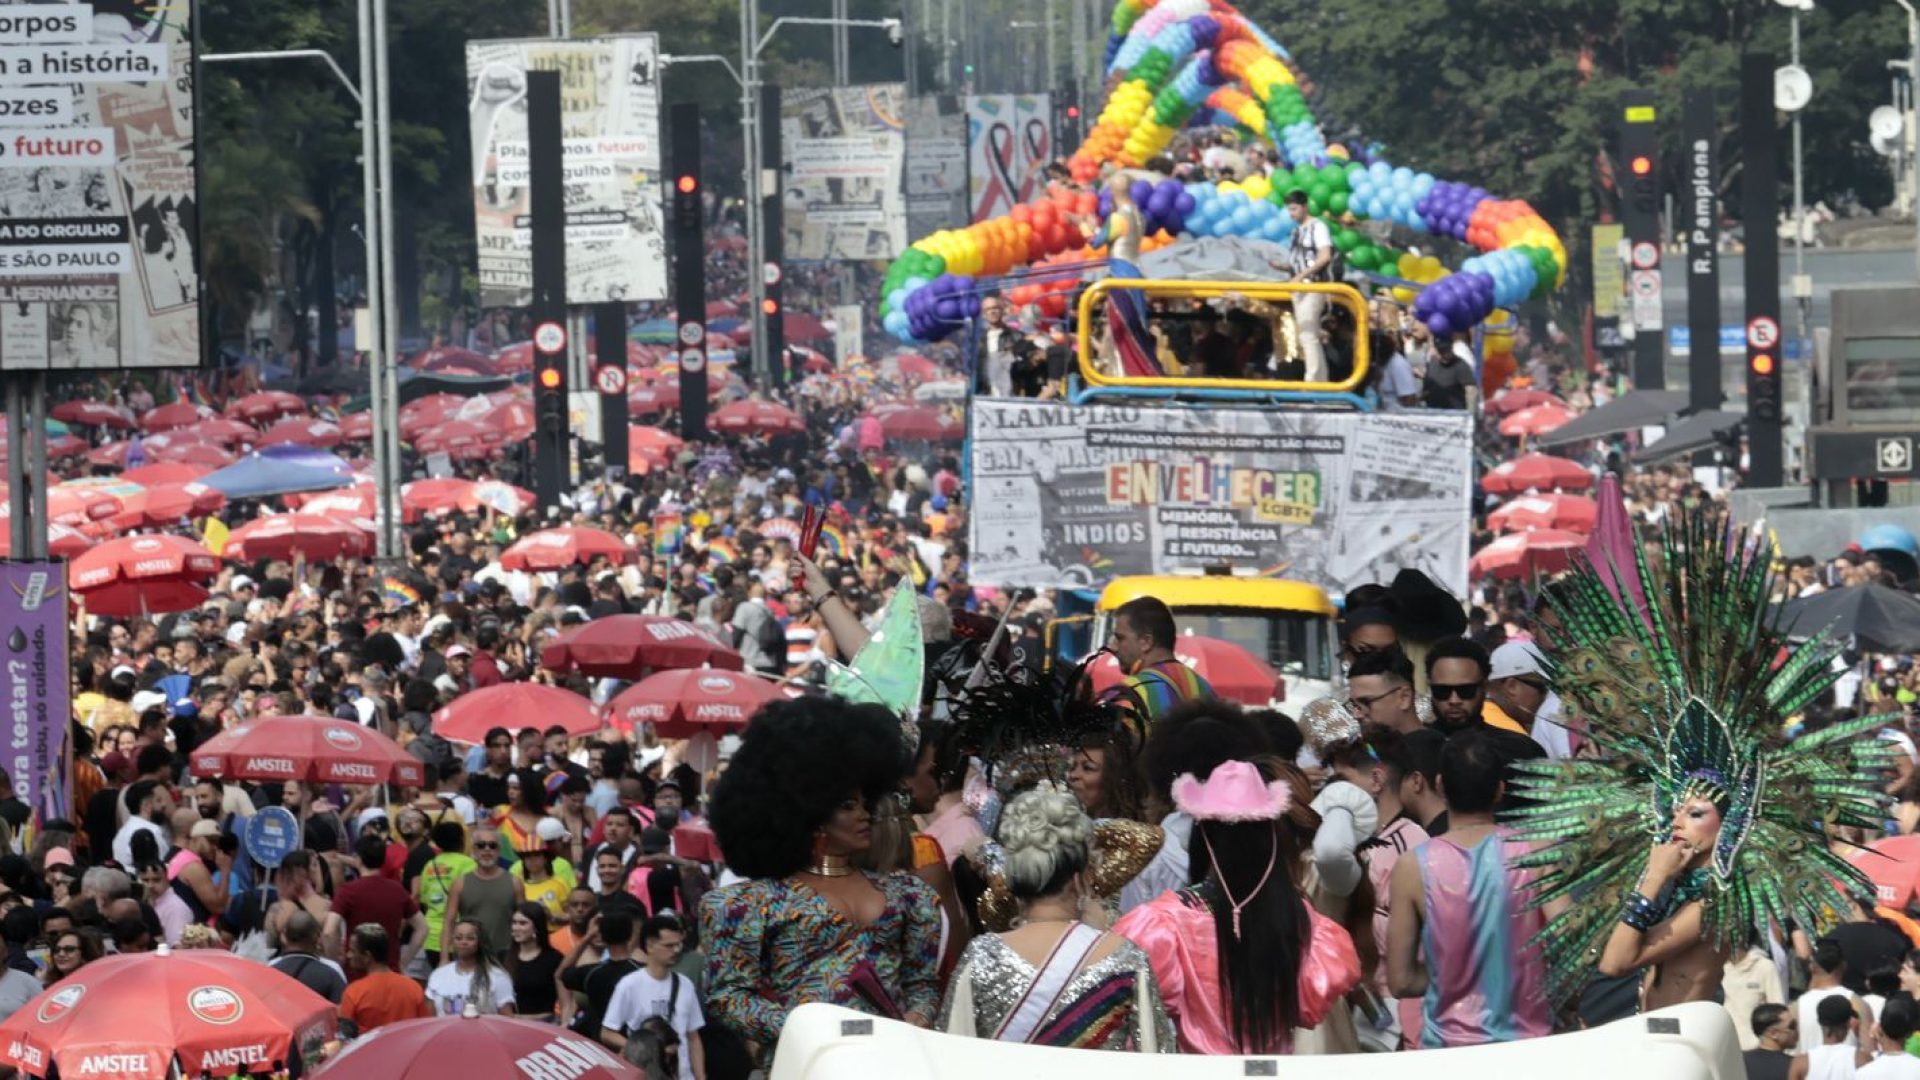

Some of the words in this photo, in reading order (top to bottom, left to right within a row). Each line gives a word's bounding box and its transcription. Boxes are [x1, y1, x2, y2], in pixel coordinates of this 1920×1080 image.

[18, 58, 32, 74] a
[42, 50, 159, 76] história,
[15, 136, 104, 157] futuro
[563, 164, 612, 179] gulho
[1692, 139, 1715, 244] Pamplona
[14, 224, 40, 238] DO
[42, 223, 121, 237] ORGULHO
[12, 250, 51, 267] SÃO
[57, 251, 121, 267] PAULO
[1692, 251, 1712, 274] R.
[1108, 457, 1320, 507] ENVELHECER
[1262, 502, 1313, 519] LGBT+
[1063, 521, 1146, 545] INDIOS
[1169, 542, 1179, 554] E
[31, 624, 46, 699] cuidado.
[8, 659, 29, 749] testar?
[35, 702, 48, 723] só
[628, 704, 665, 718] AMSTEL
[697, 704, 743, 718] AMSTEL
[35, 726, 50, 772] tabu,
[246, 758, 295, 773] AMSTEL
[330, 763, 376, 778] AMSTEL
[80, 1054, 149, 1074] AMSTEL
[201, 1045, 269, 1069] AMSTEL
